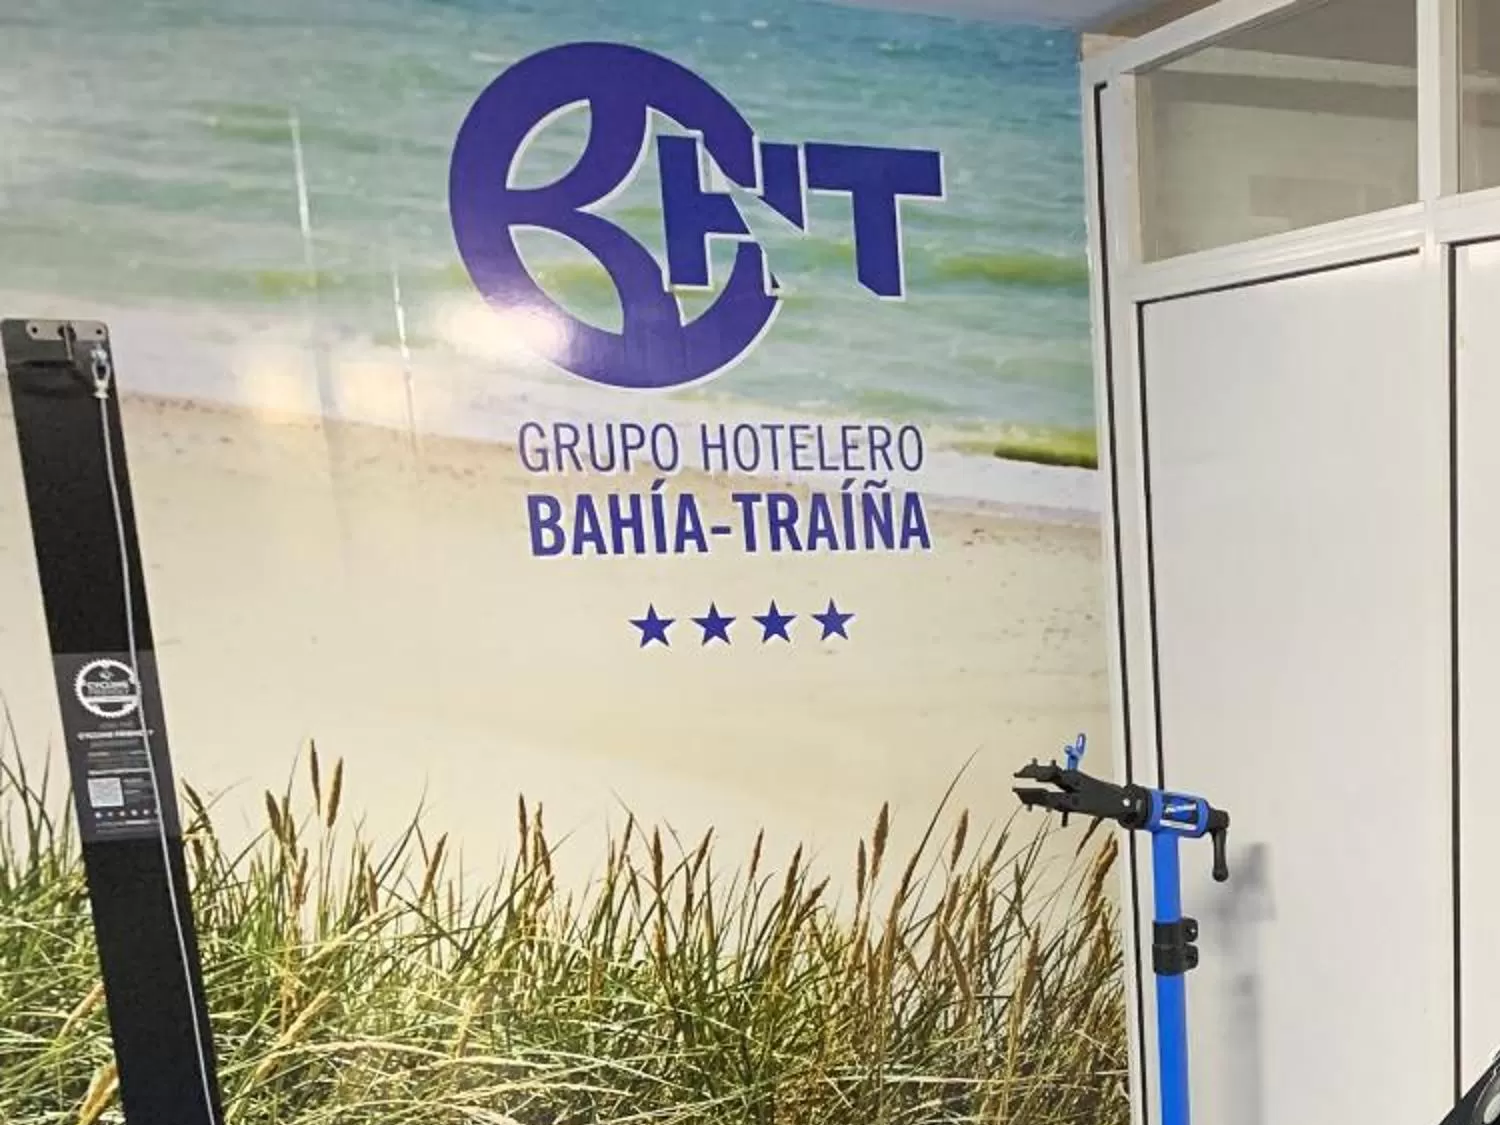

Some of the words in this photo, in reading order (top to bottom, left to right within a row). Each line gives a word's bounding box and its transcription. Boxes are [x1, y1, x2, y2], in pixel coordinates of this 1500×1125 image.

[518, 422, 679, 473] GRUPO
[701, 423, 923, 472] HOTELERO
[527, 478, 931, 556] BAHÍA-TRAÍÑA
